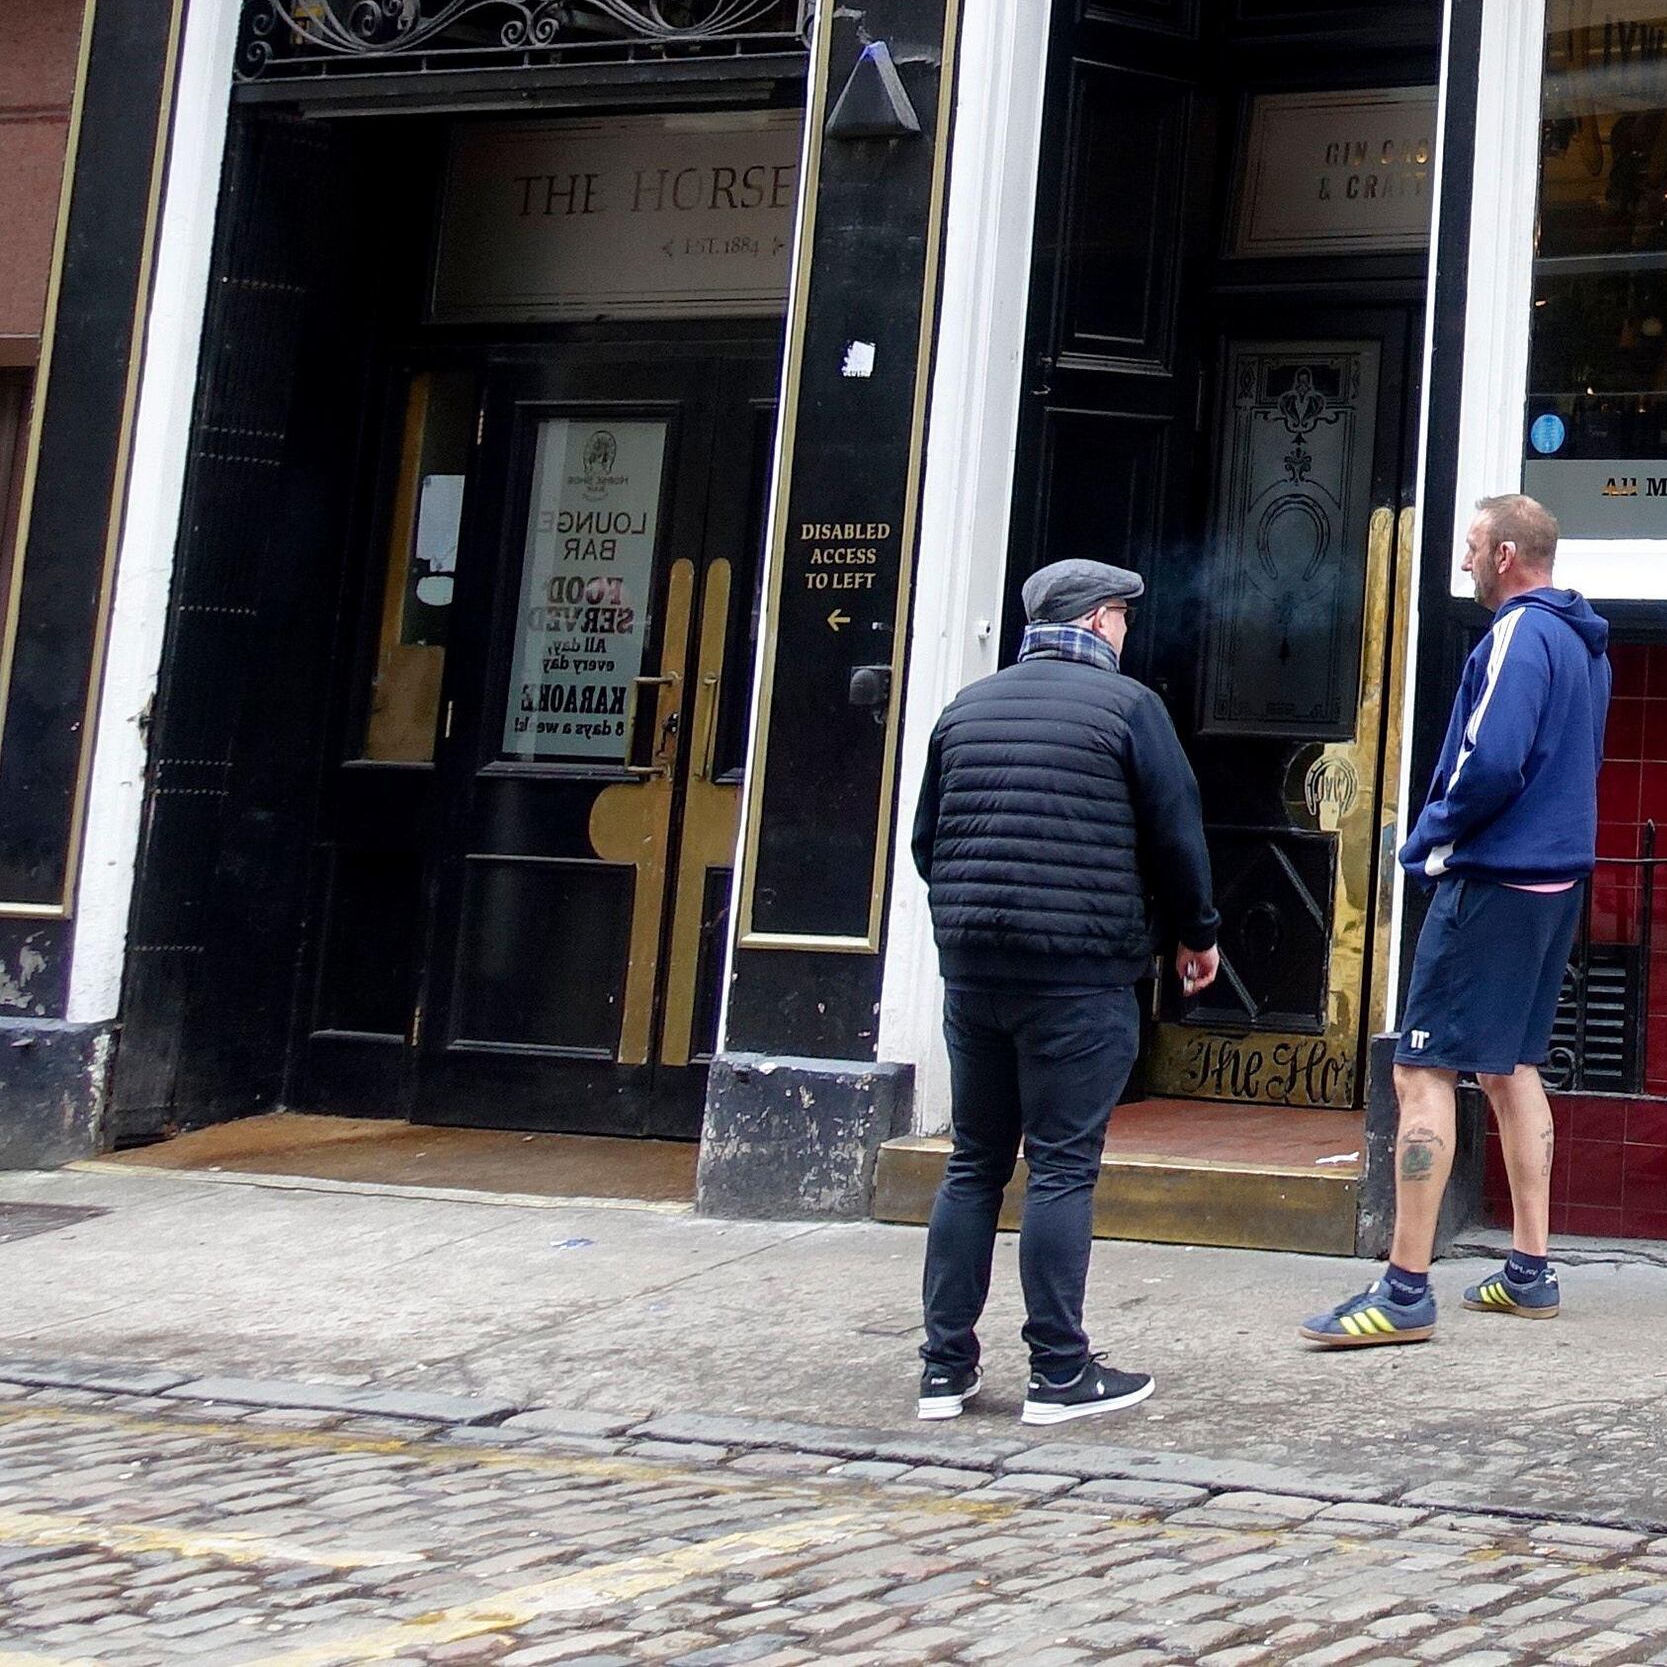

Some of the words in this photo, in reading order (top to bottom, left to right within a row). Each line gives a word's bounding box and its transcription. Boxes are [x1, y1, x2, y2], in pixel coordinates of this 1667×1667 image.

[513, 173, 604, 217] THE
[1601, 477, 1638, 496] All
[800, 523, 891, 541] DISABLED
[810, 547, 877, 565] ACCESS
[805, 573, 829, 590] TO
[832, 573, 877, 589] LEFT
[1182, 1038, 1264, 1098] The
